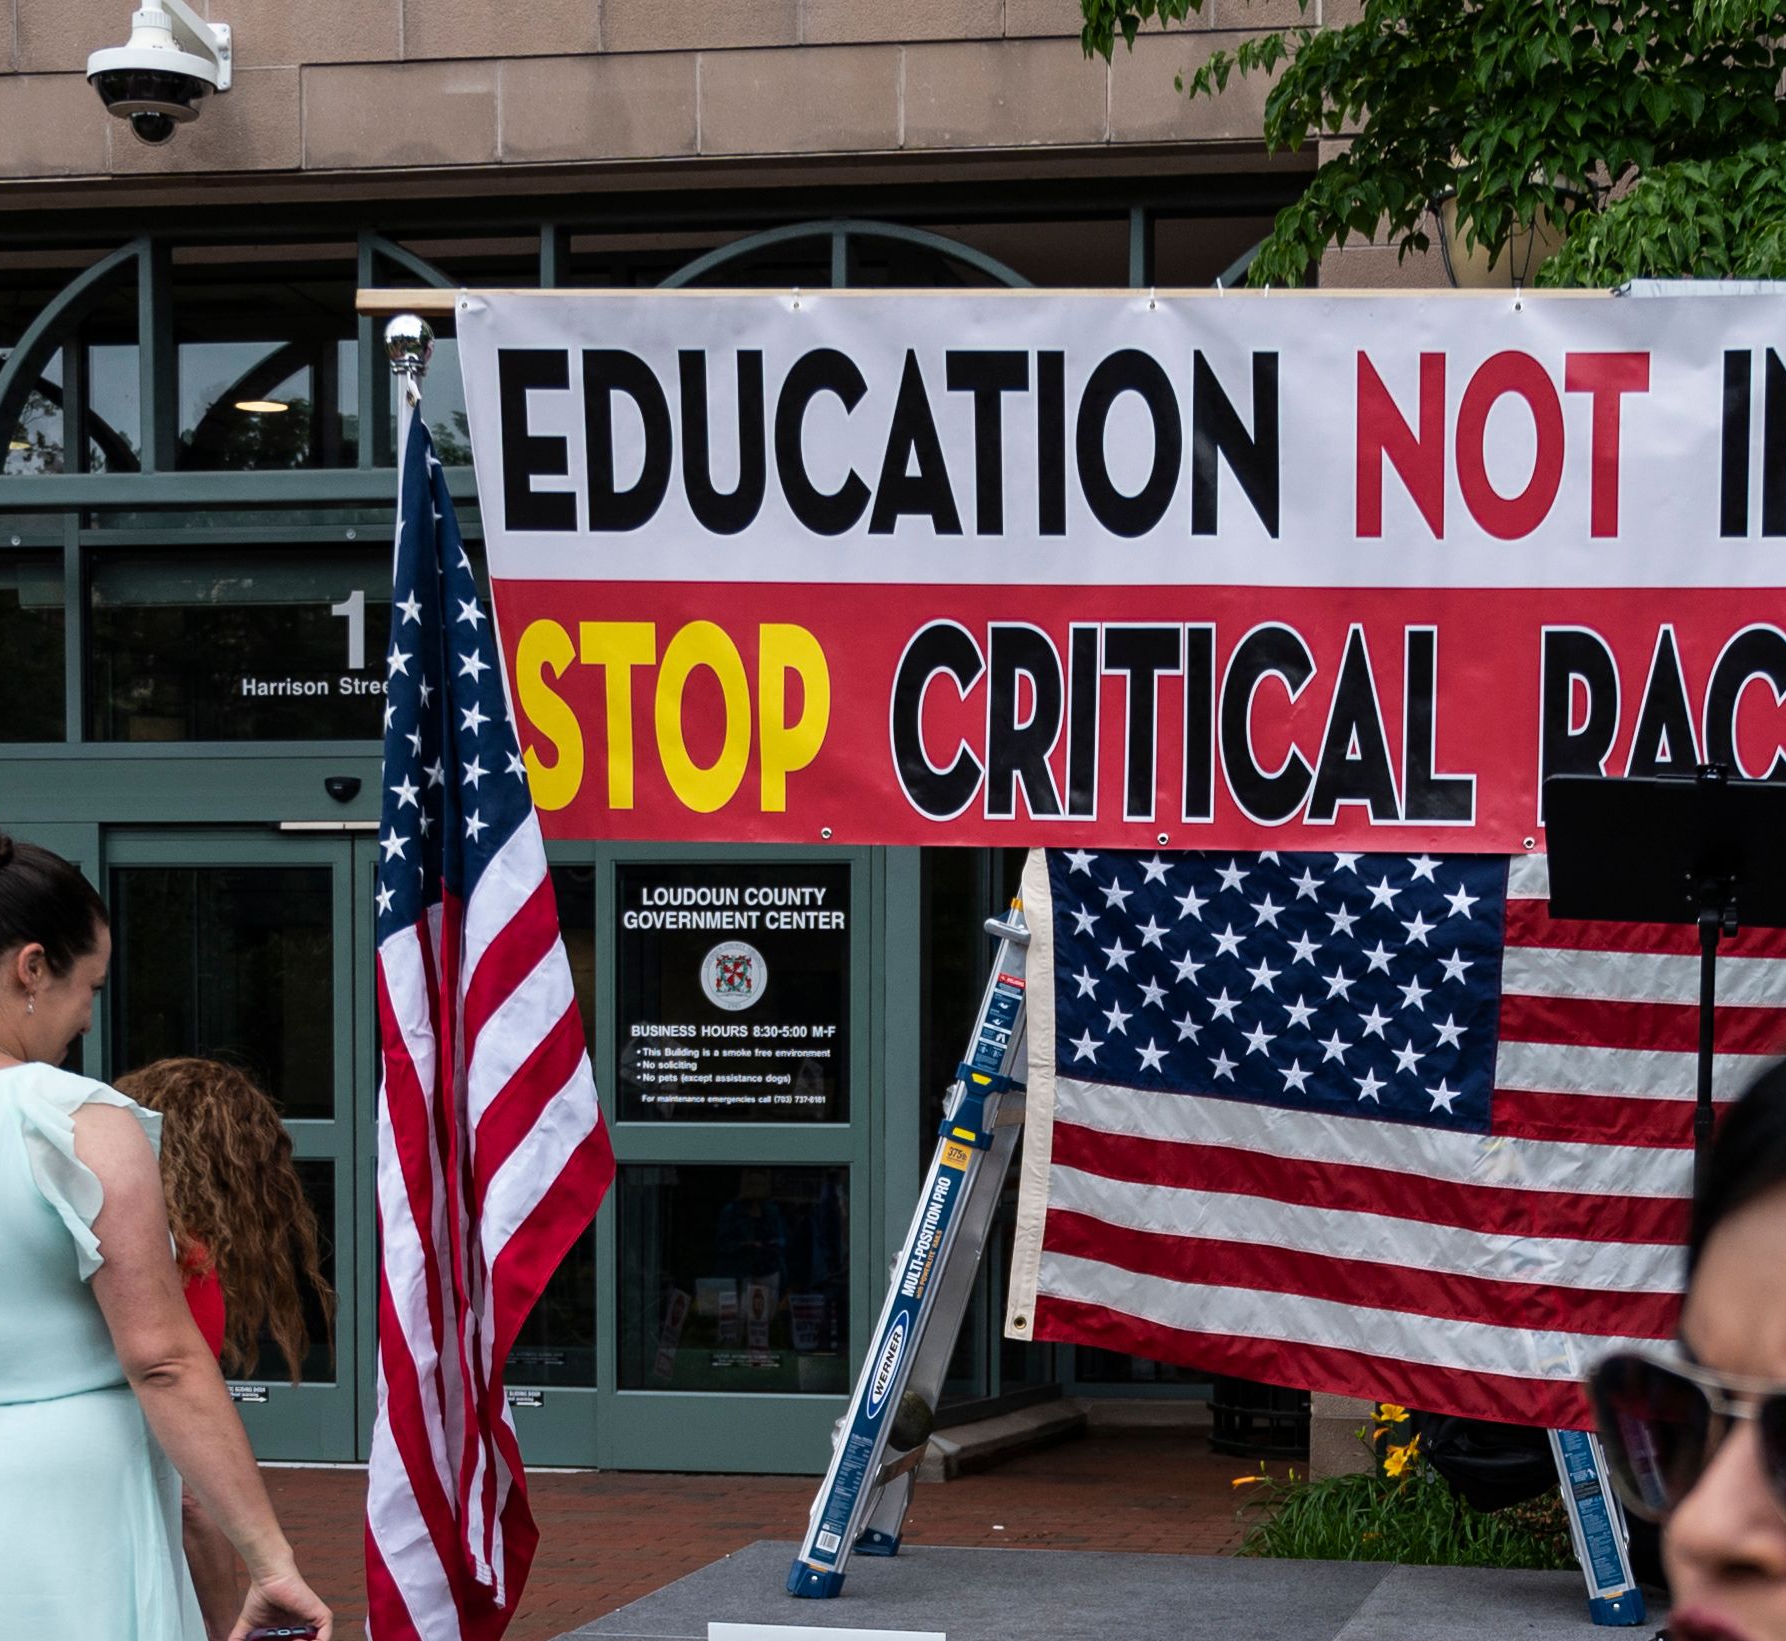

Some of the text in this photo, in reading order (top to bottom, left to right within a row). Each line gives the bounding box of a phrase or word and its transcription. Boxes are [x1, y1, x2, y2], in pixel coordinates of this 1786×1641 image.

[498, 347, 1281, 539] EDUCATION
[1356, 350, 1650, 541] NOT
[332, 590, 365, 669] 1
[242, 677, 389, 696] Harrison Stree
[516, 618, 831, 813] STOP
[889, 620, 1477, 827] CRITICAL
[642, 887, 827, 906] LOUDOUN COUNTY
[623, 911, 845, 930] GOVERNMENT CENTER
[631, 1025, 836, 1038] BUSINESS HOURS 8:30-5:00 M-F
[642, 1048, 661, 1057] This
[664, 1048, 700, 1059] Building
[702, 1048, 710, 1057] is
[722, 1048, 752, 1057] smoke
[754, 1048, 772, 1057] free
[775, 1049, 831, 1058] environment
[642, 1061, 697, 1071] No soliciting
[642, 1073, 791, 1084] No pets (except assistance dogs)
[641, 1095, 655, 1103] For
[758, 1095, 771, 1103] call
[901, 1176, 952, 1298] MULTI-POSITION PRO
[874, 1331, 901, 1396] WERNER
